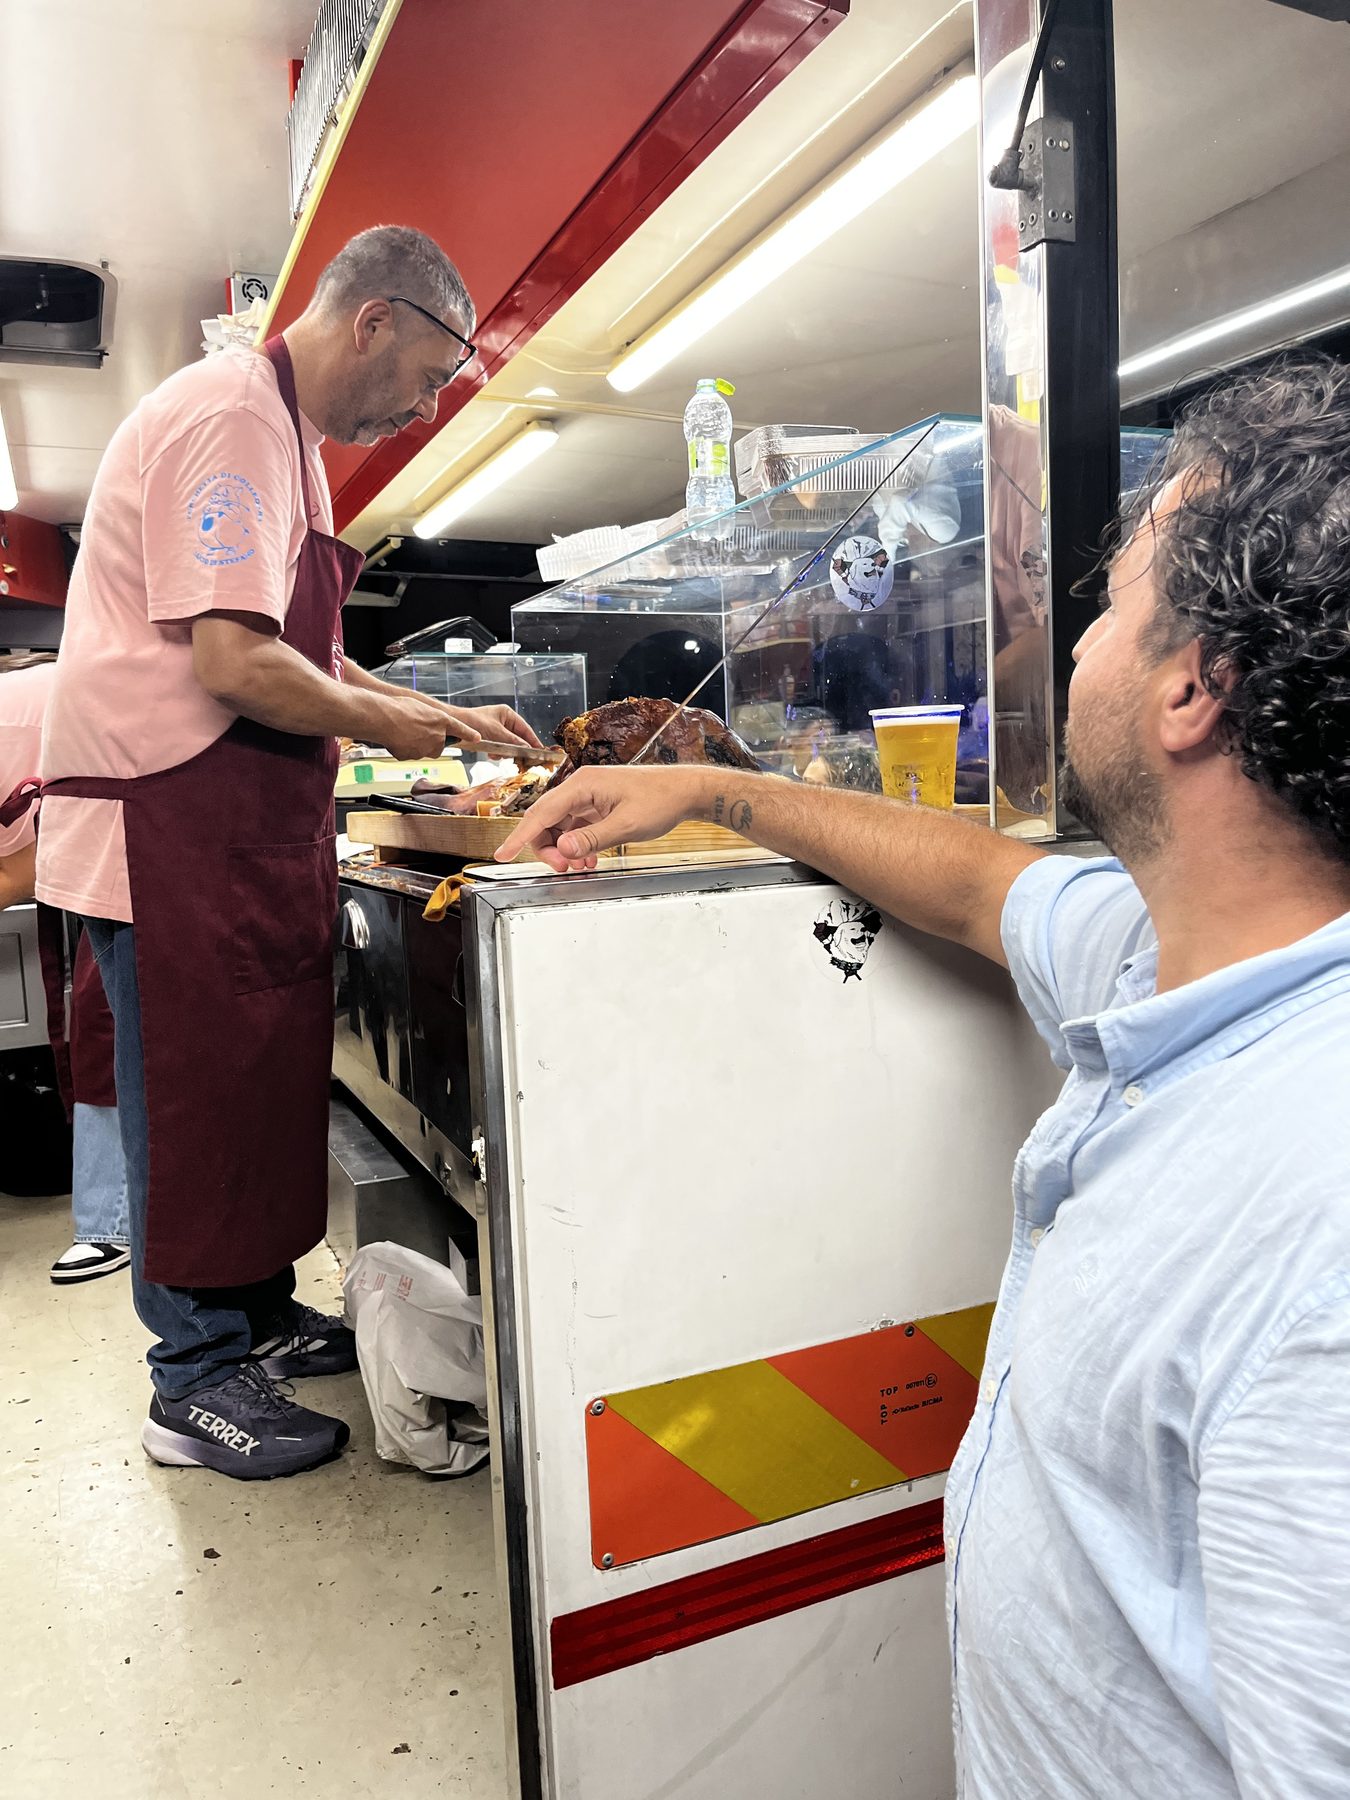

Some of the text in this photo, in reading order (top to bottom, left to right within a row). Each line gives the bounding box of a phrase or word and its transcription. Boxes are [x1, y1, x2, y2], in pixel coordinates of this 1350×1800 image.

[879, 1386, 899, 1397] TOP
[880, 1404, 888, 1425] TOP
[187, 1405, 261, 1457] TERREX
